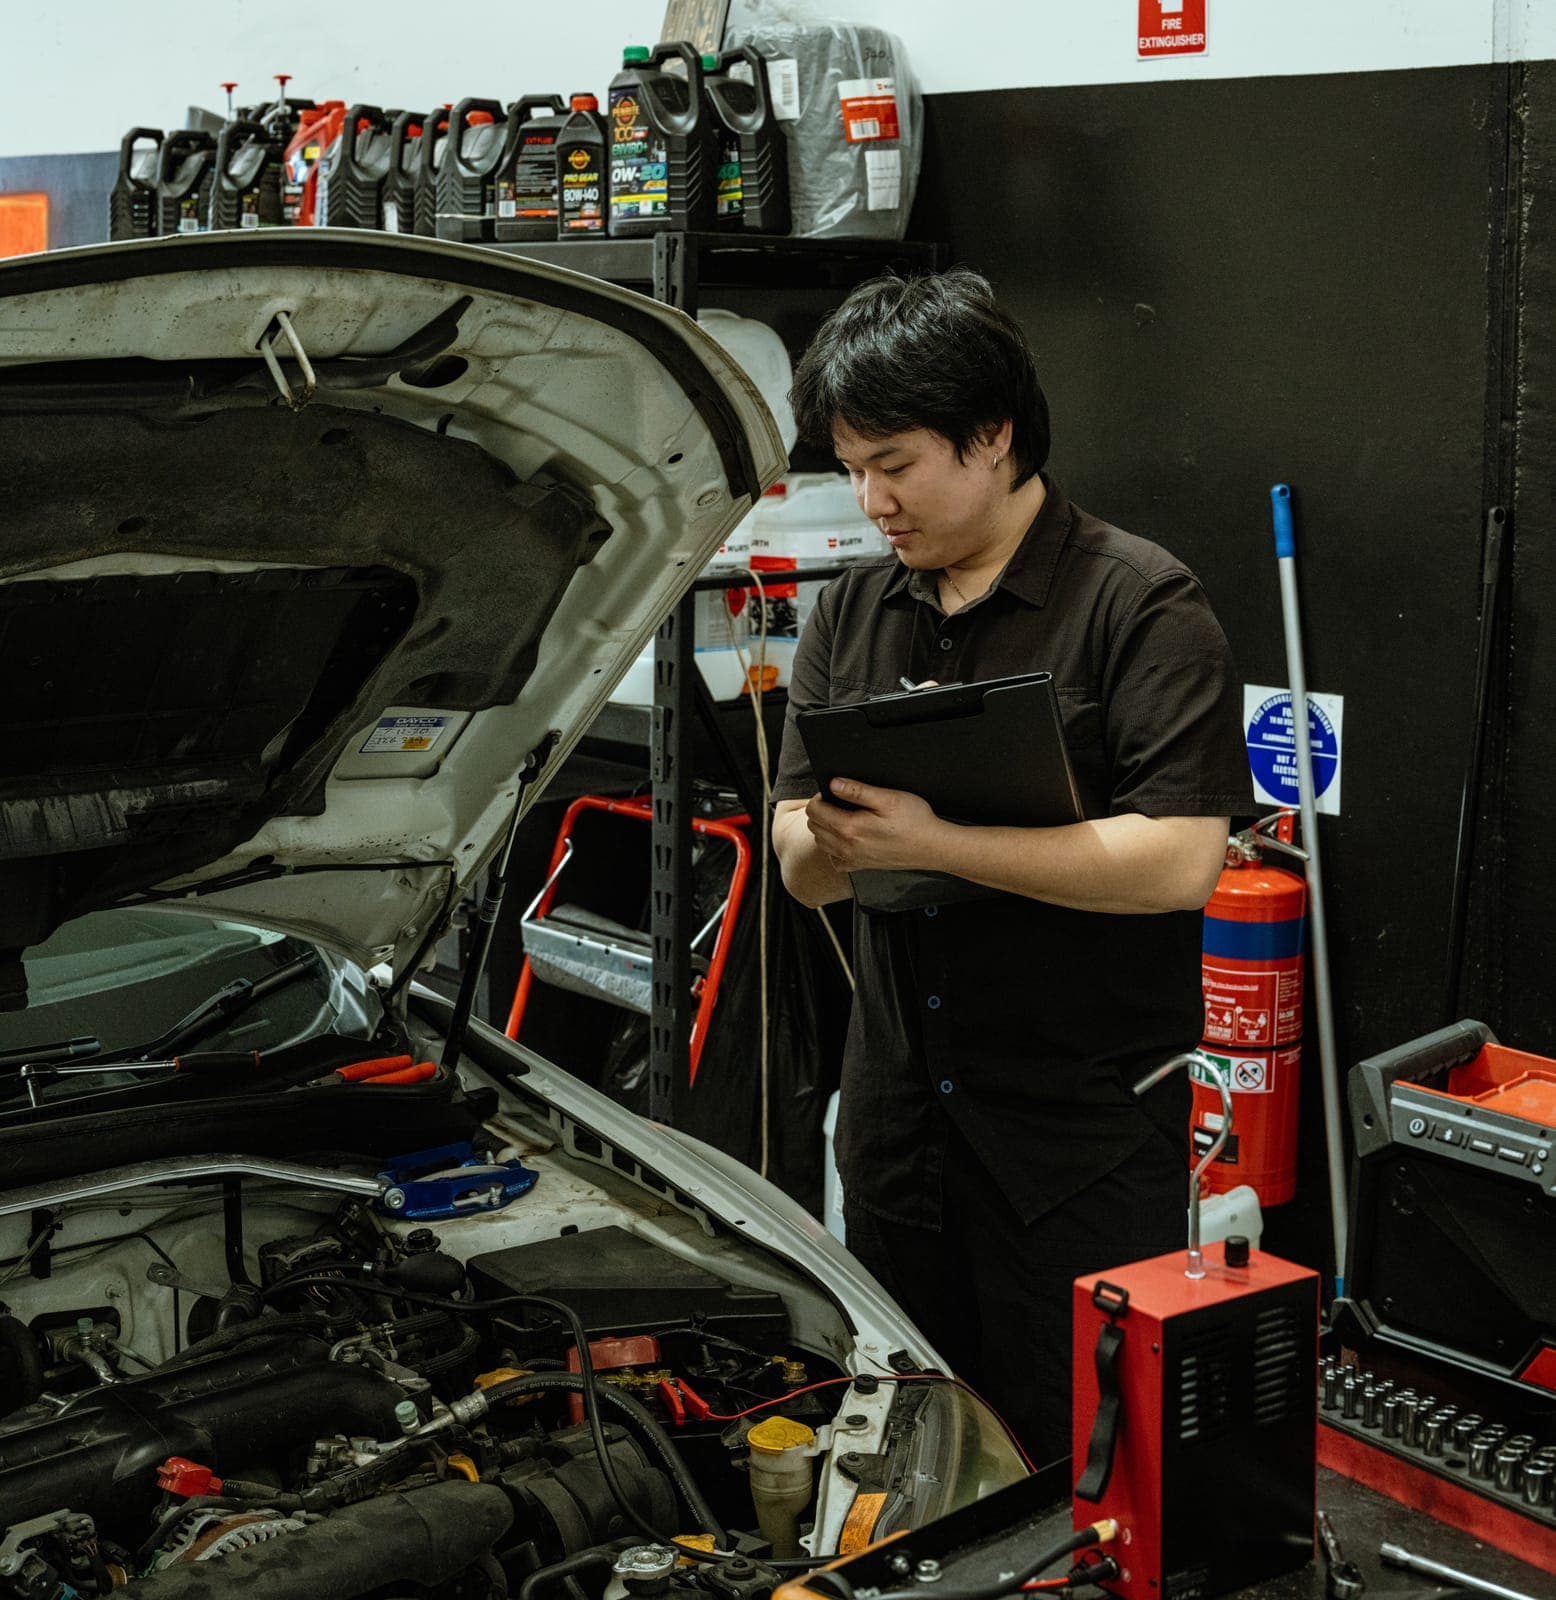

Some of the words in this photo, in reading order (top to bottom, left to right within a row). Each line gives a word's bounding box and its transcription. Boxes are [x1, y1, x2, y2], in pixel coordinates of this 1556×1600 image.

[1161, 18, 1182, 31] FIRE
[1139, 34, 1205, 49] EXTINGUISHER
[612, 163, 666, 182] 0W-20
